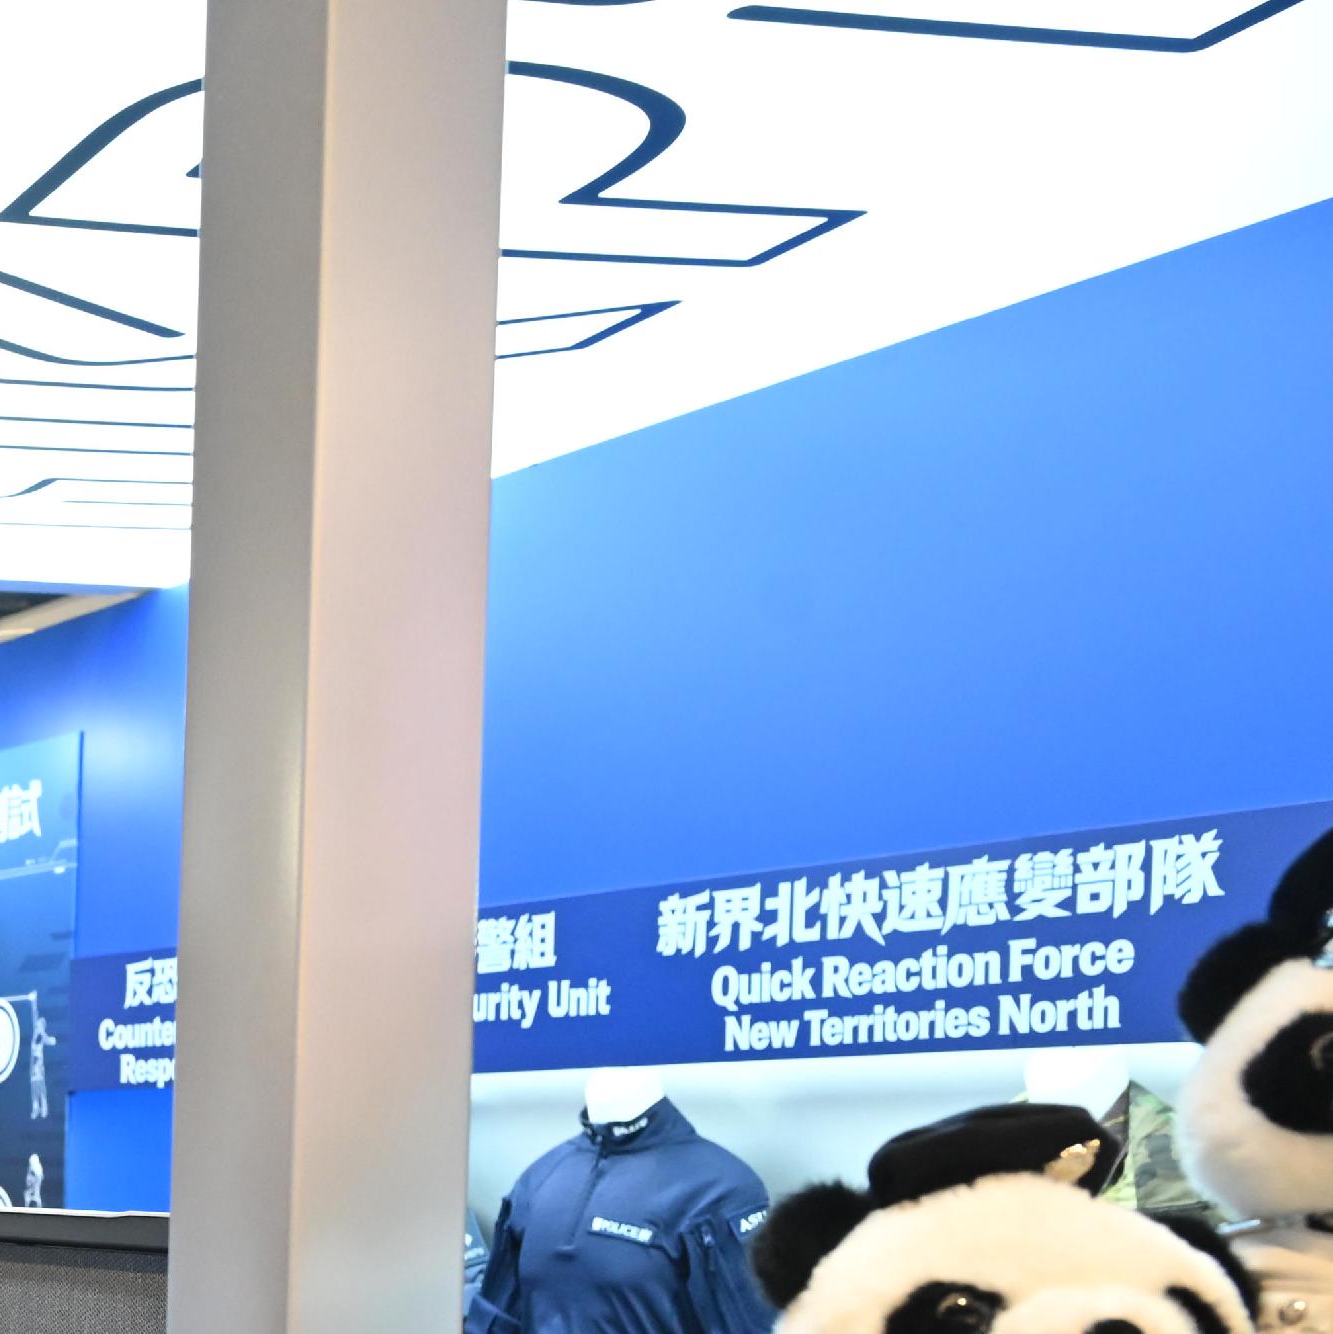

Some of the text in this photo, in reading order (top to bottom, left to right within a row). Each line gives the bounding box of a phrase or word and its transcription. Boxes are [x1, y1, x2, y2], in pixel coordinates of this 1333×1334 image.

[656, 828, 1225, 958] 新界北快速應變部隊
[547, 977, 612, 1018] Unit
[712, 933, 1135, 1013] Quick Reaction Force
[723, 985, 1121, 1053] New Territories North
